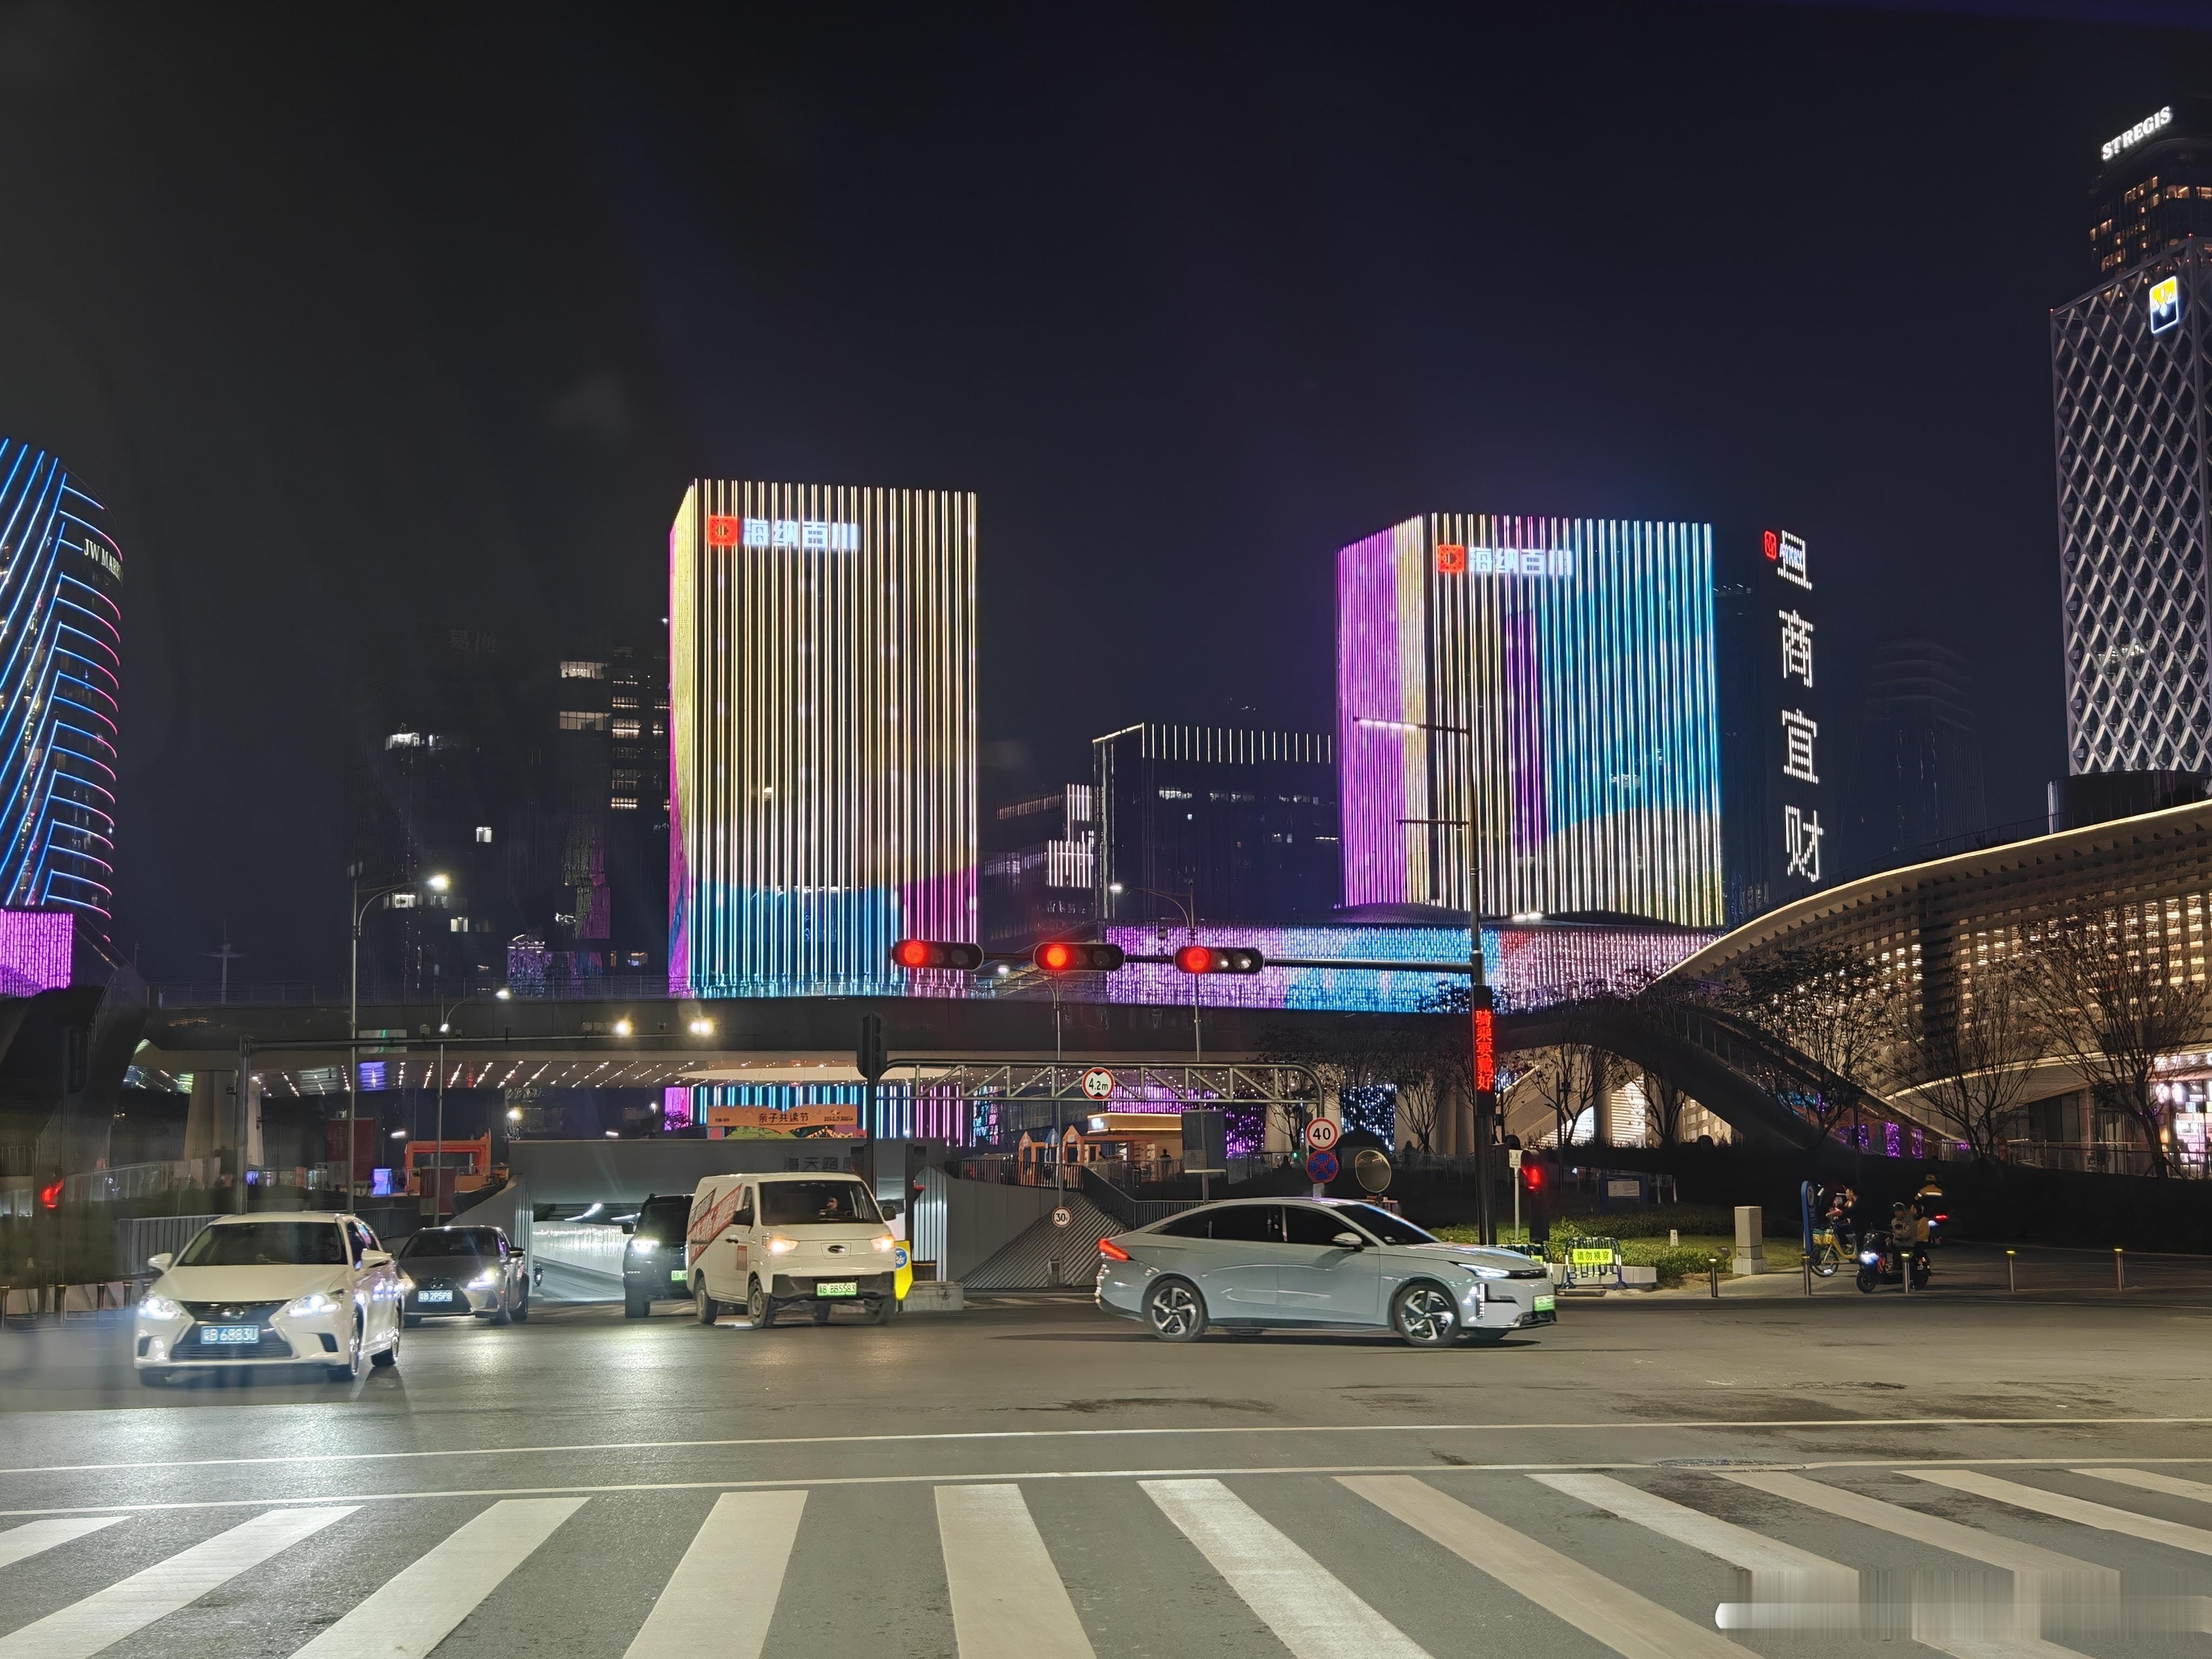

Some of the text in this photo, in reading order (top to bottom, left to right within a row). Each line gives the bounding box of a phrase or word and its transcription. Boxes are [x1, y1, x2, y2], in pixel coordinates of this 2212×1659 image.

[2122, 106, 2171, 148] REGIS
[743, 518, 858, 550] 海纳百川
[84, 538, 100, 562] JW
[1469, 547, 1572, 576] 海纳百川
[1475, 1009, 1494, 1090] 骑乘要戴好
[1089, 1077, 1108, 1090] 4.2m
[758, 1112, 808, 1123] 亲子共读节
[1313, 1128, 1331, 1140] 40
[1577, 1251, 1609, 1260] 请勿横穿
